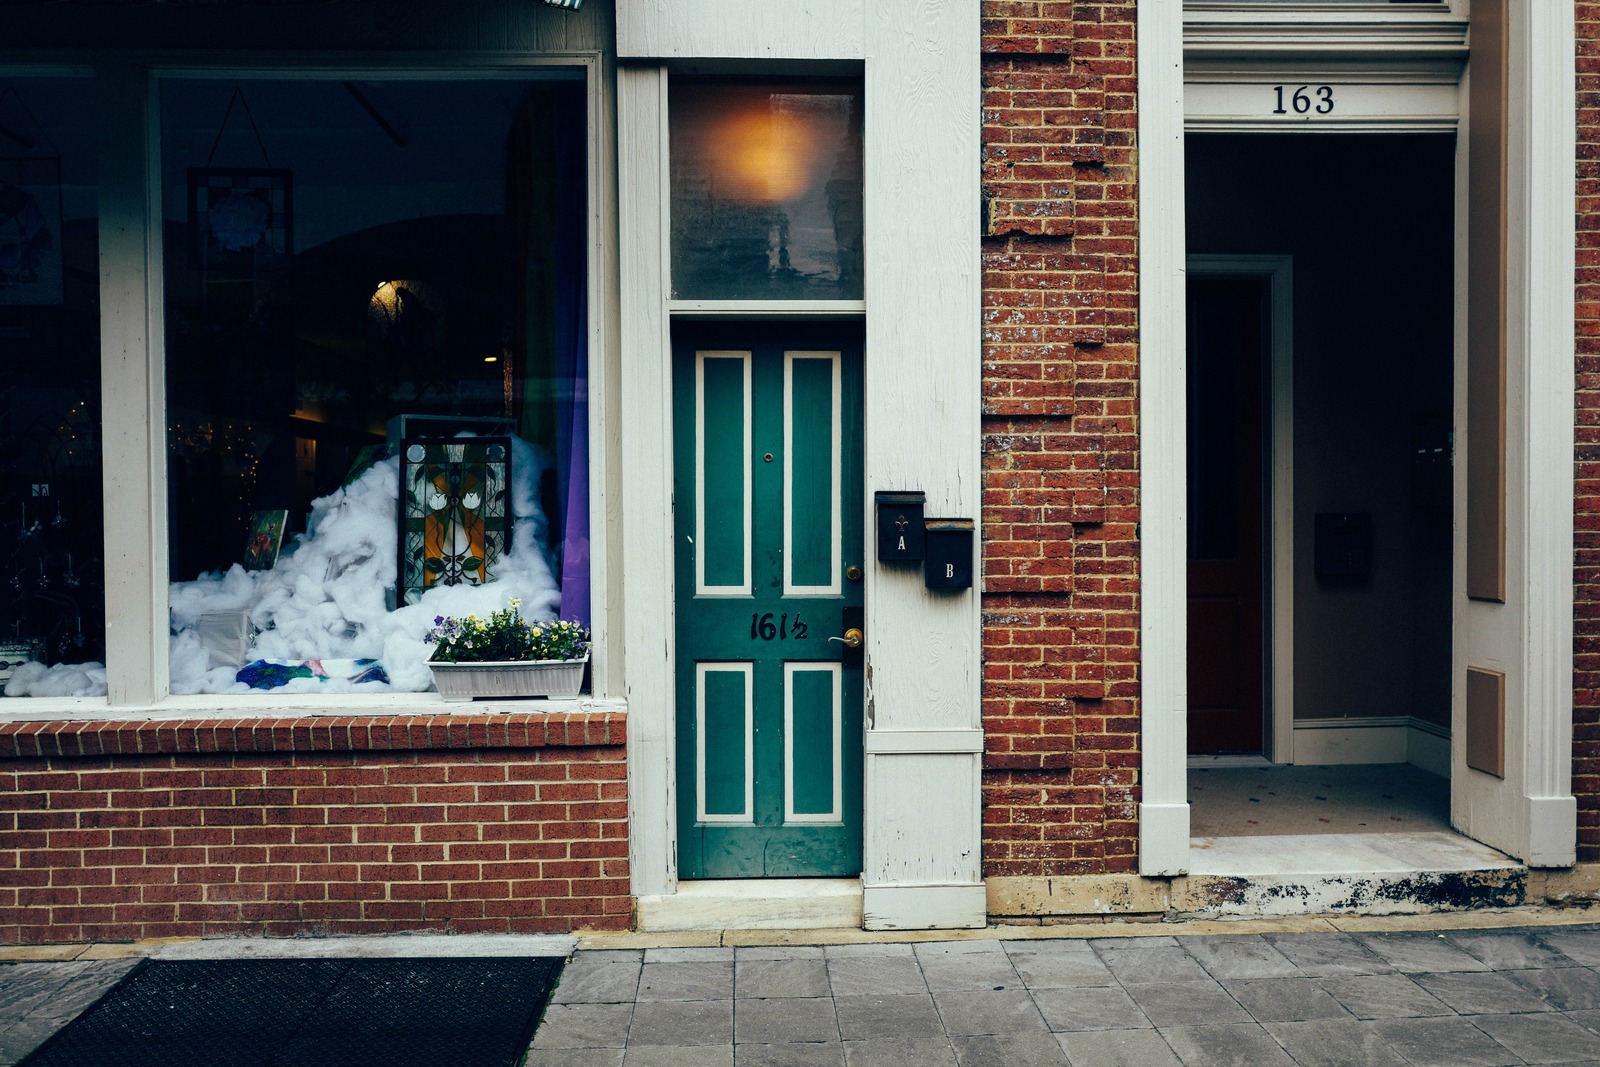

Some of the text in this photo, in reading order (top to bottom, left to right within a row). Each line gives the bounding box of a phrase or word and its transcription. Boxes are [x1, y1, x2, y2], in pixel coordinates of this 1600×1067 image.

[1273, 86, 1334, 114] 163
[897, 535, 906, 550] A
[945, 563, 954, 578] B
